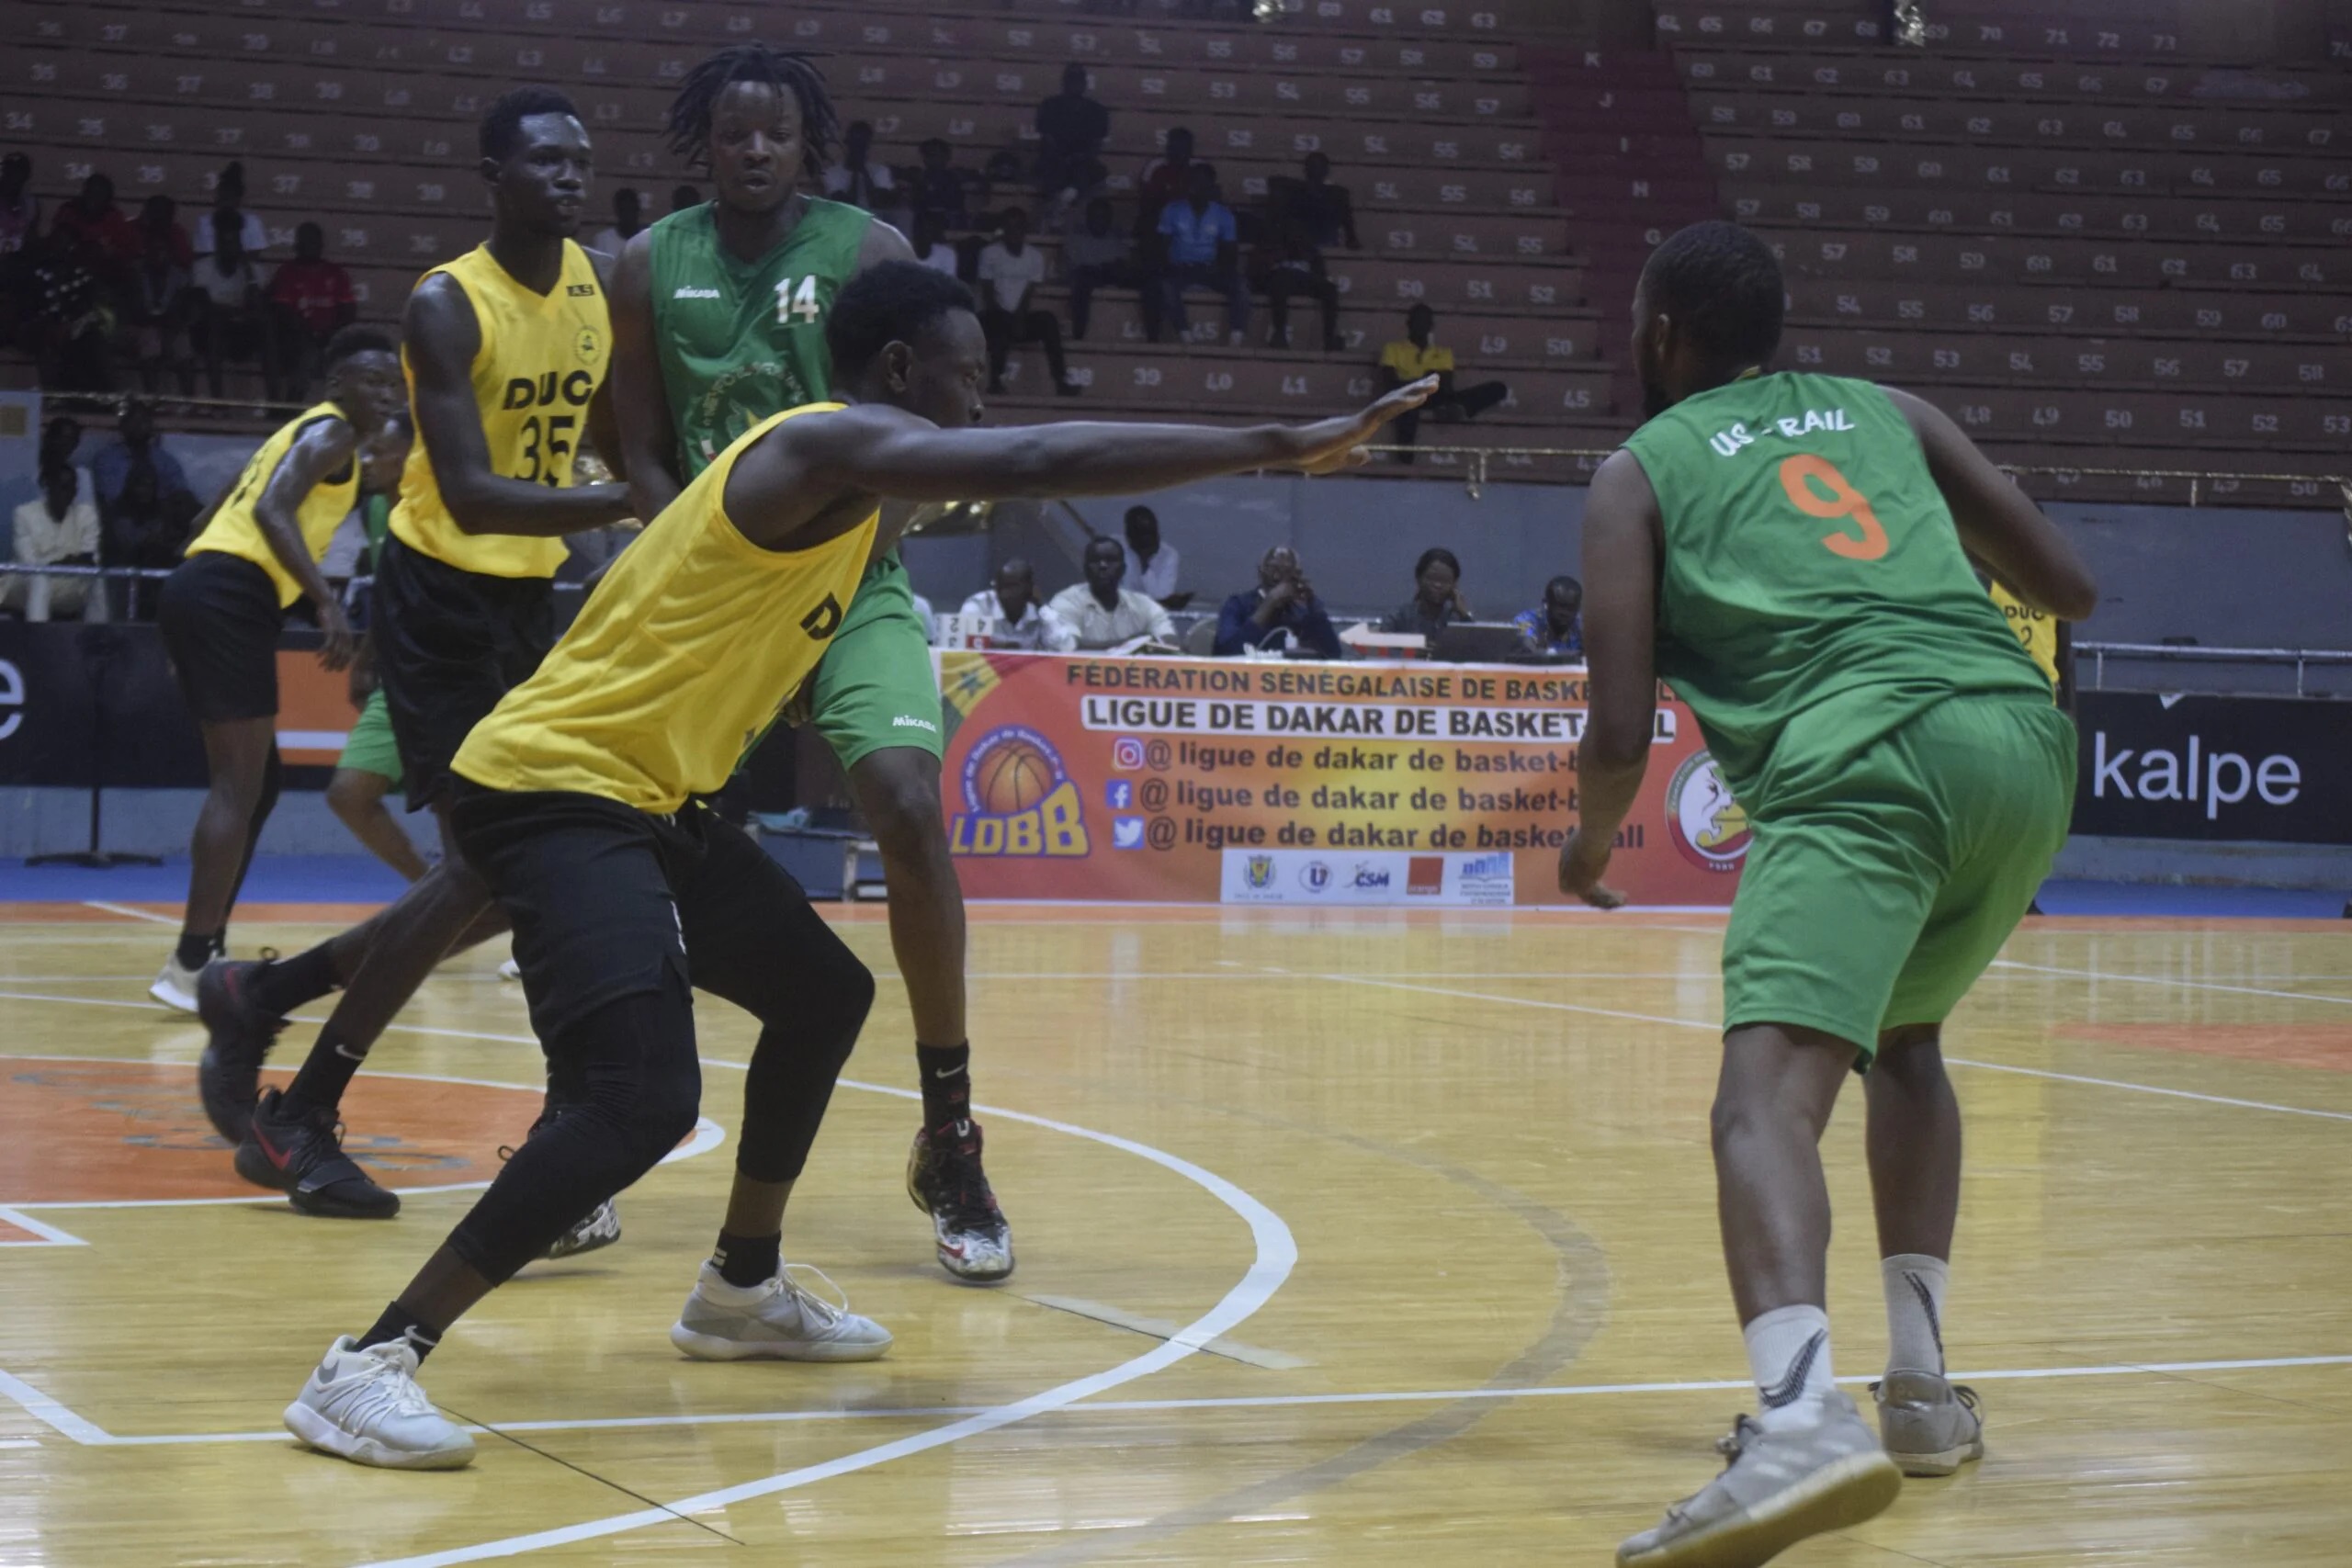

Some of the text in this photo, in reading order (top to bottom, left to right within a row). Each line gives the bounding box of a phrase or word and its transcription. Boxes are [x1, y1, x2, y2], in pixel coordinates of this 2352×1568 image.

[1370, 8, 1393, 23] 61
[1421, 10, 1445, 25] 62
[1471, 13, 1496, 28] 63
[1699, 17, 1723, 31] 65
[1804, 20, 1827, 35] 67
[2046, 28, 2068, 44] 71
[2098, 32, 2120, 48] 72
[1586, 52, 1599, 66] K
[1884, 69, 1909, 85] 63
[1953, 71, 1975, 87] 64
[2019, 72, 2042, 88] 65
[1599, 93, 1612, 107] J
[1901, 115, 1923, 129] 61
[1968, 118, 1991, 133] 62
[2038, 119, 2063, 135] 63
[2104, 121, 2126, 137] 64
[2308, 130, 2331, 143] 67
[1726, 153, 1750, 169] 57
[1854, 156, 1879, 172] 59
[1987, 166, 2009, 182] 61
[2055, 168, 2078, 184] 62
[2120, 170, 2144, 186] 63
[2191, 167, 2214, 185] 64
[2257, 169, 2281, 184] 65
[1633, 181, 1648, 197] H
[1736, 199, 1760, 214] 57
[1865, 206, 1890, 220] 59
[2058, 213, 2083, 227] 62
[2121, 214, 2147, 230] 63
[2197, 214, 2220, 231] 64
[2260, 215, 2284, 231] 65
[1388, 231, 1414, 247] 53
[1518, 236, 1543, 253] 55
[1822, 243, 1847, 260] 57
[1893, 245, 1917, 263] 58
[1960, 252, 1985, 269] 59
[2093, 254, 2117, 272] 61
[2162, 259, 2186, 275] 62
[2231, 264, 2256, 278] 63
[2300, 264, 2324, 281] 64
[1397, 279, 1424, 297] 50
[1467, 280, 1492, 298] 51
[1531, 285, 1555, 302] 52
[774, 275, 820, 324] 14
[1838, 295, 1861, 313] 54
[1898, 300, 1924, 318] 55
[1968, 304, 1994, 321] 56
[2049, 305, 2074, 322] 57
[2114, 305, 2139, 322] 58
[2197, 309, 2222, 326] 59
[2261, 312, 2287, 328] 60
[1546, 338, 1573, 355] 50
[1797, 345, 1822, 362] 51
[1866, 346, 1892, 365] 52
[1934, 350, 1960, 367] 53
[2009, 352, 2032, 371] 54
[2078, 355, 2104, 371] 55
[2154, 358, 2179, 376] 56
[2224, 359, 2249, 377] 57
[2299, 365, 2324, 380] 58
[1134, 367, 1161, 386] 39
[502, 369, 594, 411] DUC
[2033, 407, 2060, 425] 49
[2105, 410, 2132, 428] 50
[2180, 410, 2205, 427] 51
[2253, 414, 2278, 432] 52
[2324, 415, 2351, 434] 53
[1710, 422, 1755, 457] US
[1777, 408, 1855, 437] RAIL
[518, 415, 575, 488] 35
[1779, 454, 1889, 560] 9
[1066, 662, 1250, 694] FÉDÉRATION
[1260, 667, 1453, 698] SÉNÉGALAISE
[1461, 678, 1496, 699] DE
[1087, 699, 1196, 728] LIGUE
[1209, 702, 1255, 731] DE
[1267, 705, 1384, 735] DAKAR
[1395, 709, 1437, 735] DE
[1180, 741, 1256, 773] ligue
[1267, 744, 1304, 769] de
[1313, 746, 1398, 771] dakar
[1408, 748, 1444, 772] de
[1177, 781, 1252, 813] ligue
[1264, 783, 1300, 808] de
[1311, 784, 1400, 810] dakar
[1410, 785, 1447, 811] de
[950, 782, 1089, 855] LDBB
[1185, 819, 1266, 852] ligue
[1278, 821, 1316, 846] de
[1327, 822, 1419, 848] dakar
[1430, 823, 1466, 848] de
